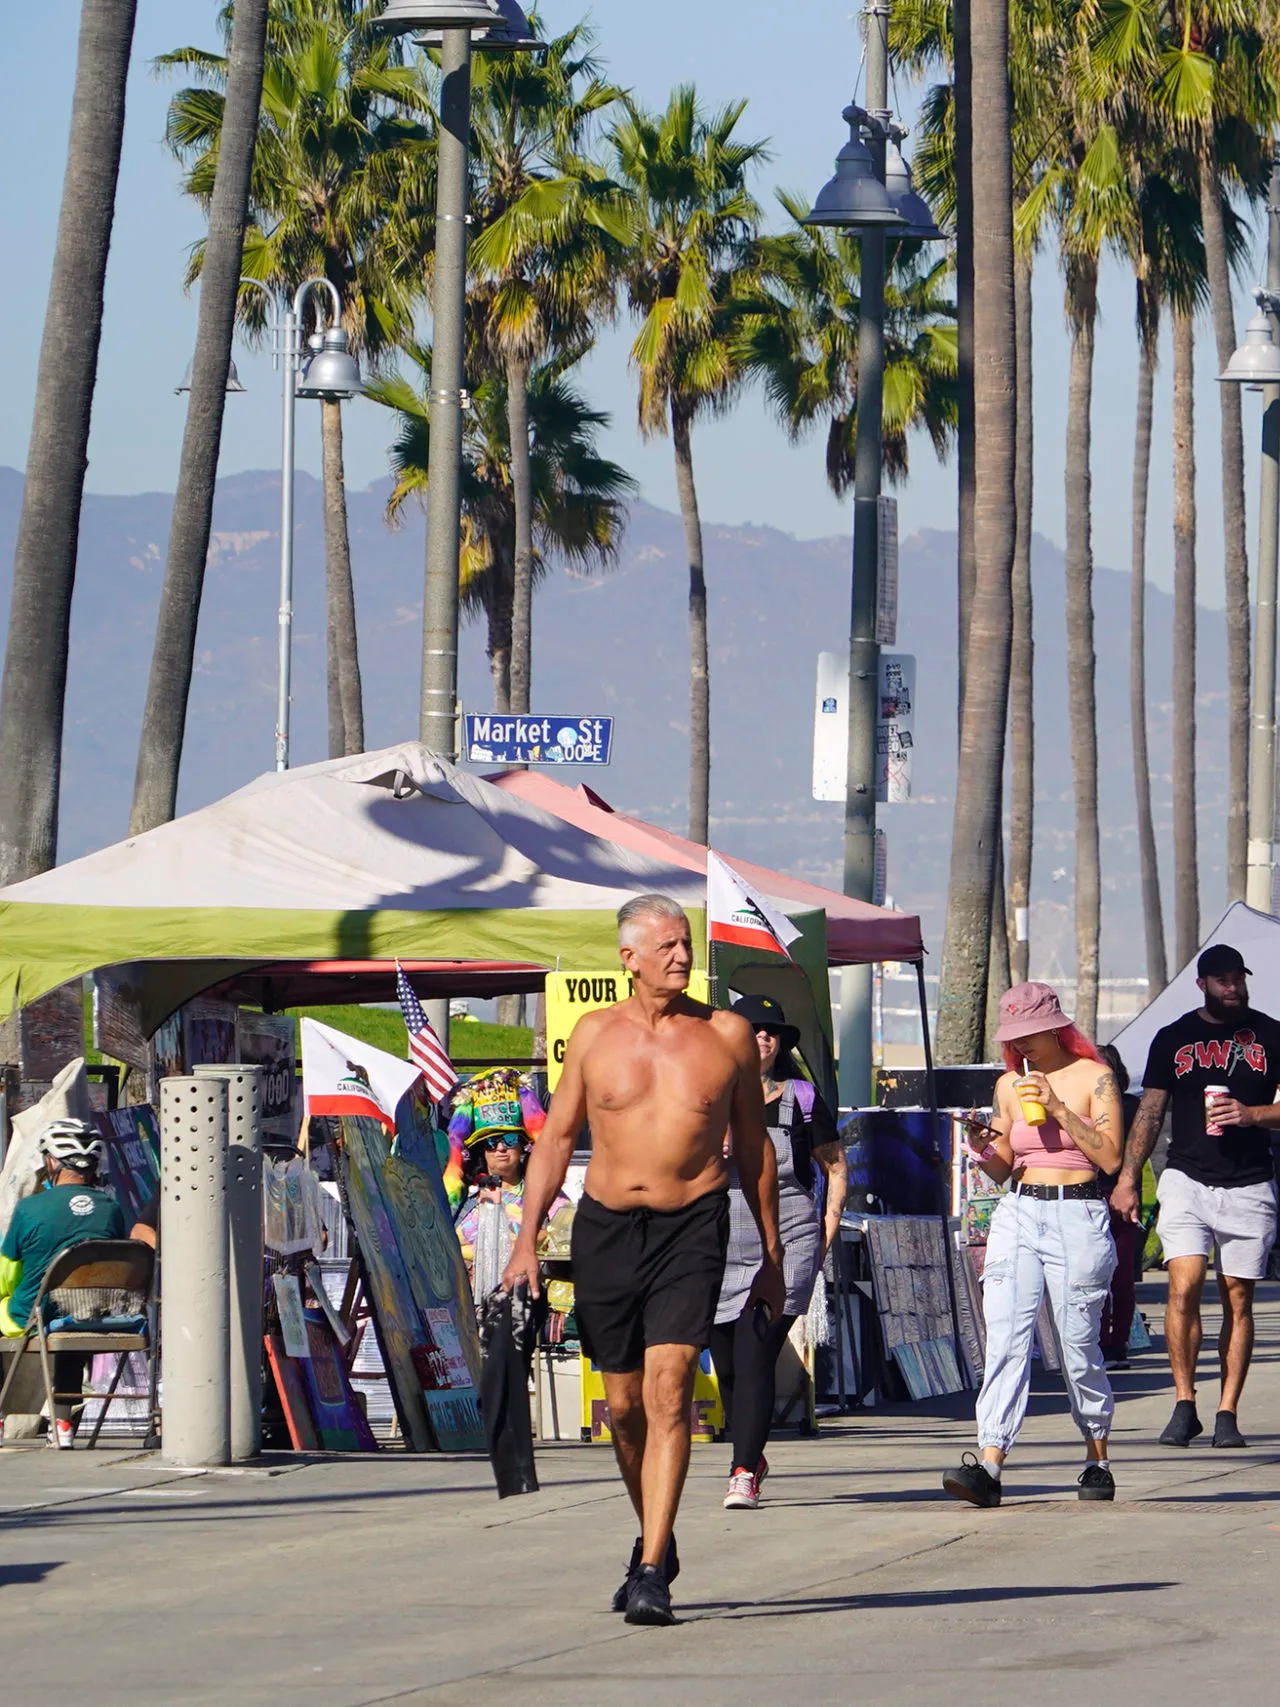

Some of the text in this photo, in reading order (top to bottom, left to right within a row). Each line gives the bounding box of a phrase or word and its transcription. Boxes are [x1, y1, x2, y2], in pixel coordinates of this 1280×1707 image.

[473, 718, 603, 744] Market St
[565, 978, 617, 1003] YOUR
[1174, 1039, 1267, 1079] SWG
[479, 1101, 518, 1121] RICE
